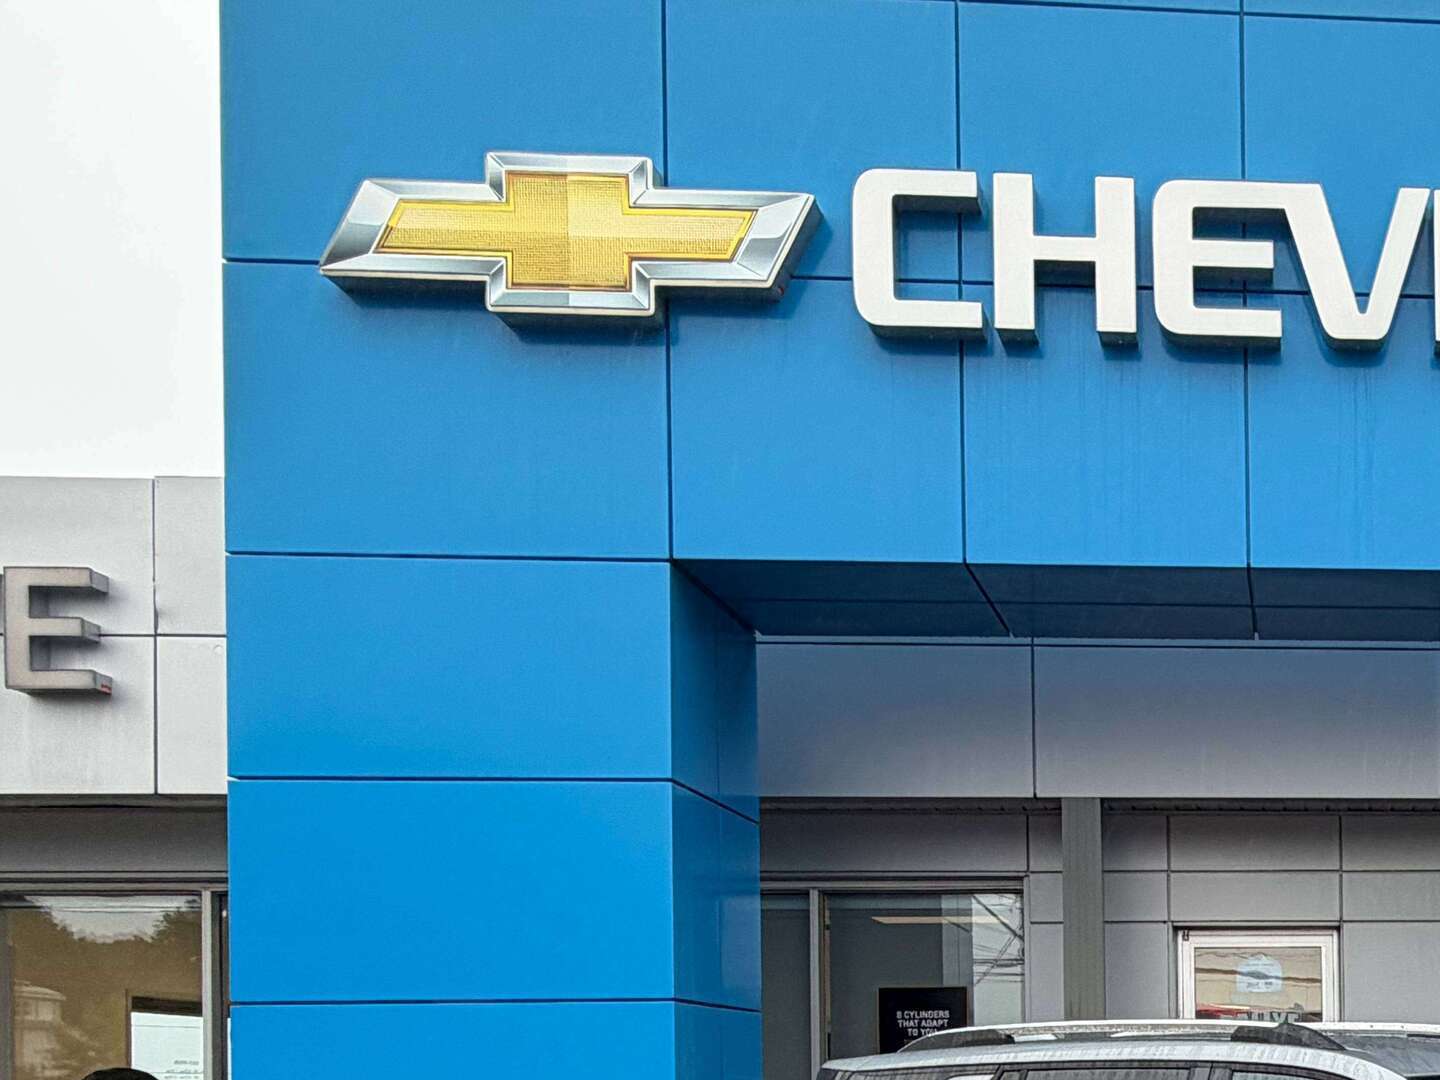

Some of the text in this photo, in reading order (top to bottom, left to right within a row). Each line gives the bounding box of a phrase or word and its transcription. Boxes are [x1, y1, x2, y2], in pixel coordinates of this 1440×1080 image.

[904, 1009, 950, 1019] CYLINDERS
[897, 1019, 949, 1028] THAT ADAPT
[907, 1028, 918, 1036] TO
